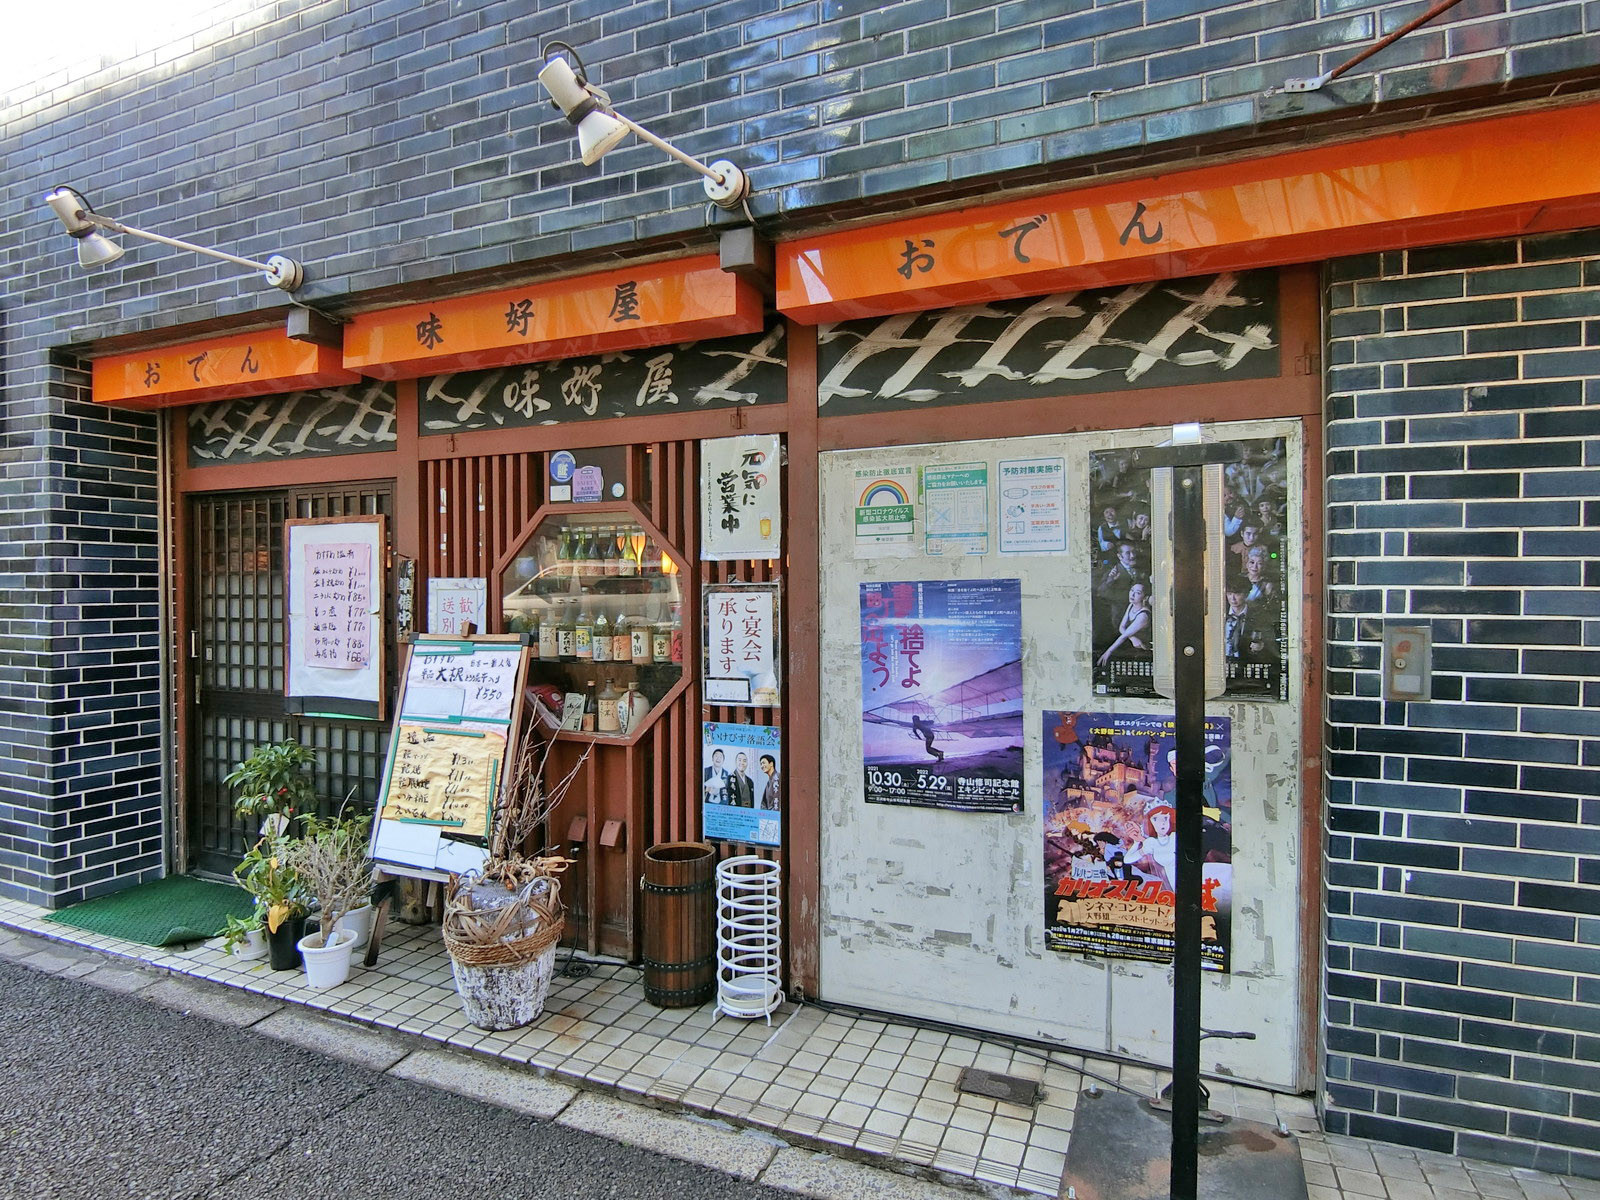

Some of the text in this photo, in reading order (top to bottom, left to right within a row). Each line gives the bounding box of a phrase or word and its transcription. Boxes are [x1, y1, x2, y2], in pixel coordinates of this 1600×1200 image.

[897, 202, 1163, 280] おでん
[416, 281, 640, 350] 味好屋
[143, 346, 258, 388] おでん
[741, 448, 765, 506] 元気に
[1003, 464, 1062, 476] 予防対策実施中
[716, 469, 740, 534] 営業中
[859, 507, 910, 516] 新型コロナウイルス
[441, 597, 456, 634] 送別
[742, 595, 762, 662] ご宴会
[718, 596, 738, 674] 承ります
[867, 771, 902, 787] 10.30
[917, 774, 947, 790] 5.29
[957, 777, 1020, 788] 寺山修司記念館
[957, 786, 1020, 795] エキジビットホール
[1072, 866, 1109, 880] ルパン三世
